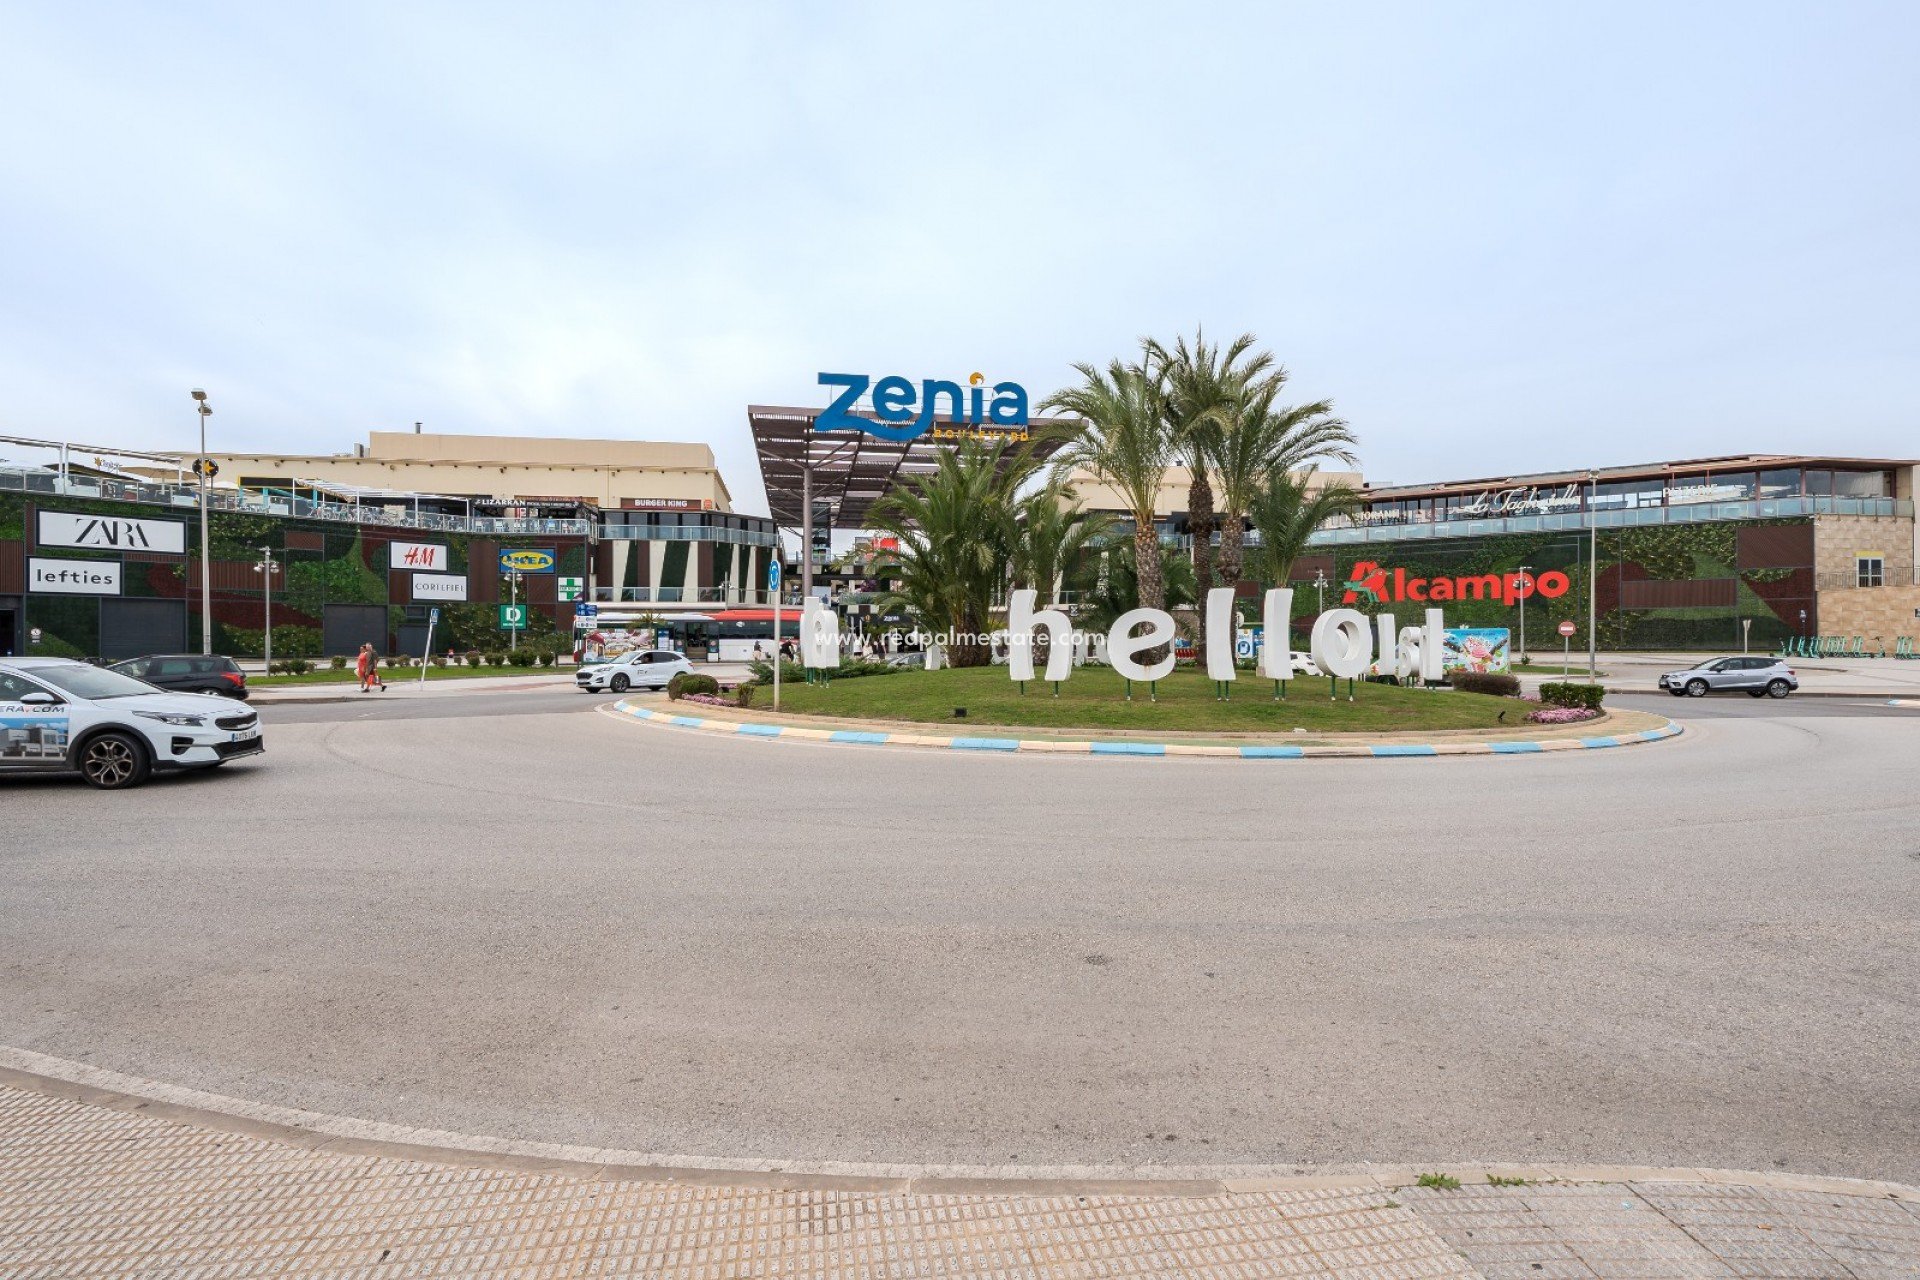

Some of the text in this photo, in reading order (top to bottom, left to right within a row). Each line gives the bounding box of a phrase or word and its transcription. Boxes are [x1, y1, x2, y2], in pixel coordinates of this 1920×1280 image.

[634, 499, 688, 508] BURGER KING
[75, 518, 150, 548] ZARA
[403, 546, 435, 568] H&M
[36, 568, 113, 585] lefties
[1341, 560, 1570, 606] Alcampo
[415, 583, 465, 592] CORTEFIEL
